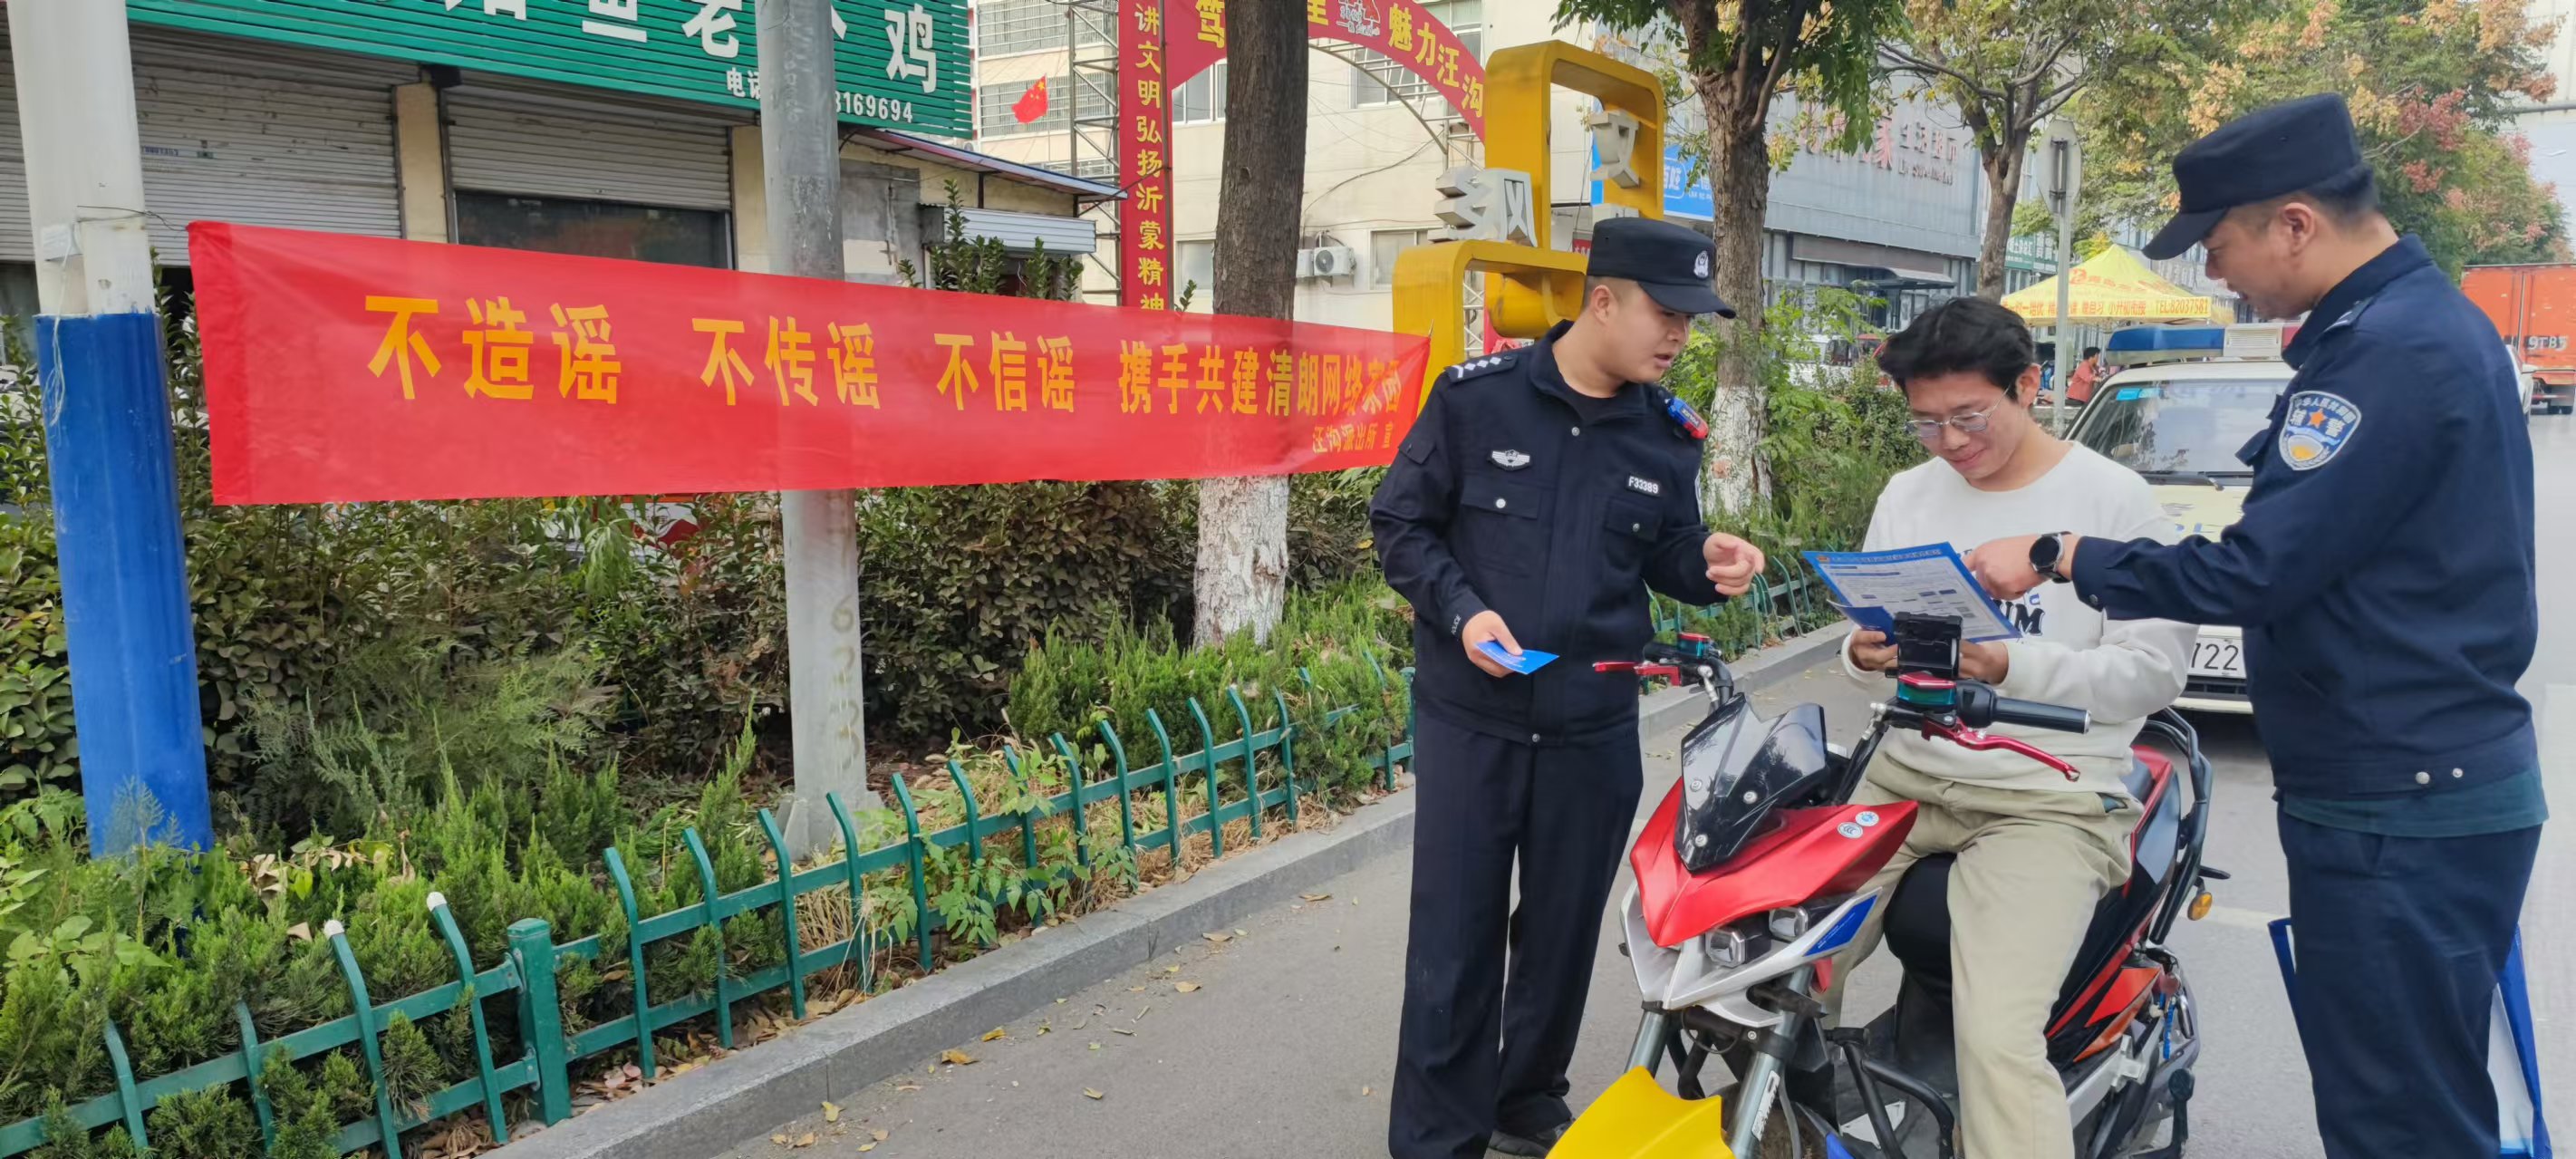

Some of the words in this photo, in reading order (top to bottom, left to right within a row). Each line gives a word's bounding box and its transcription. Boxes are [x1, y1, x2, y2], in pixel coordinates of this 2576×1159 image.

[1388, 3, 1483, 118] 魅力汪沟
[364, 295, 622, 405] 不造谣
[692, 316, 882, 409] 不传谣
[934, 331, 1076, 413] 不信谣
[1628, 475, 1659, 494] F33389
